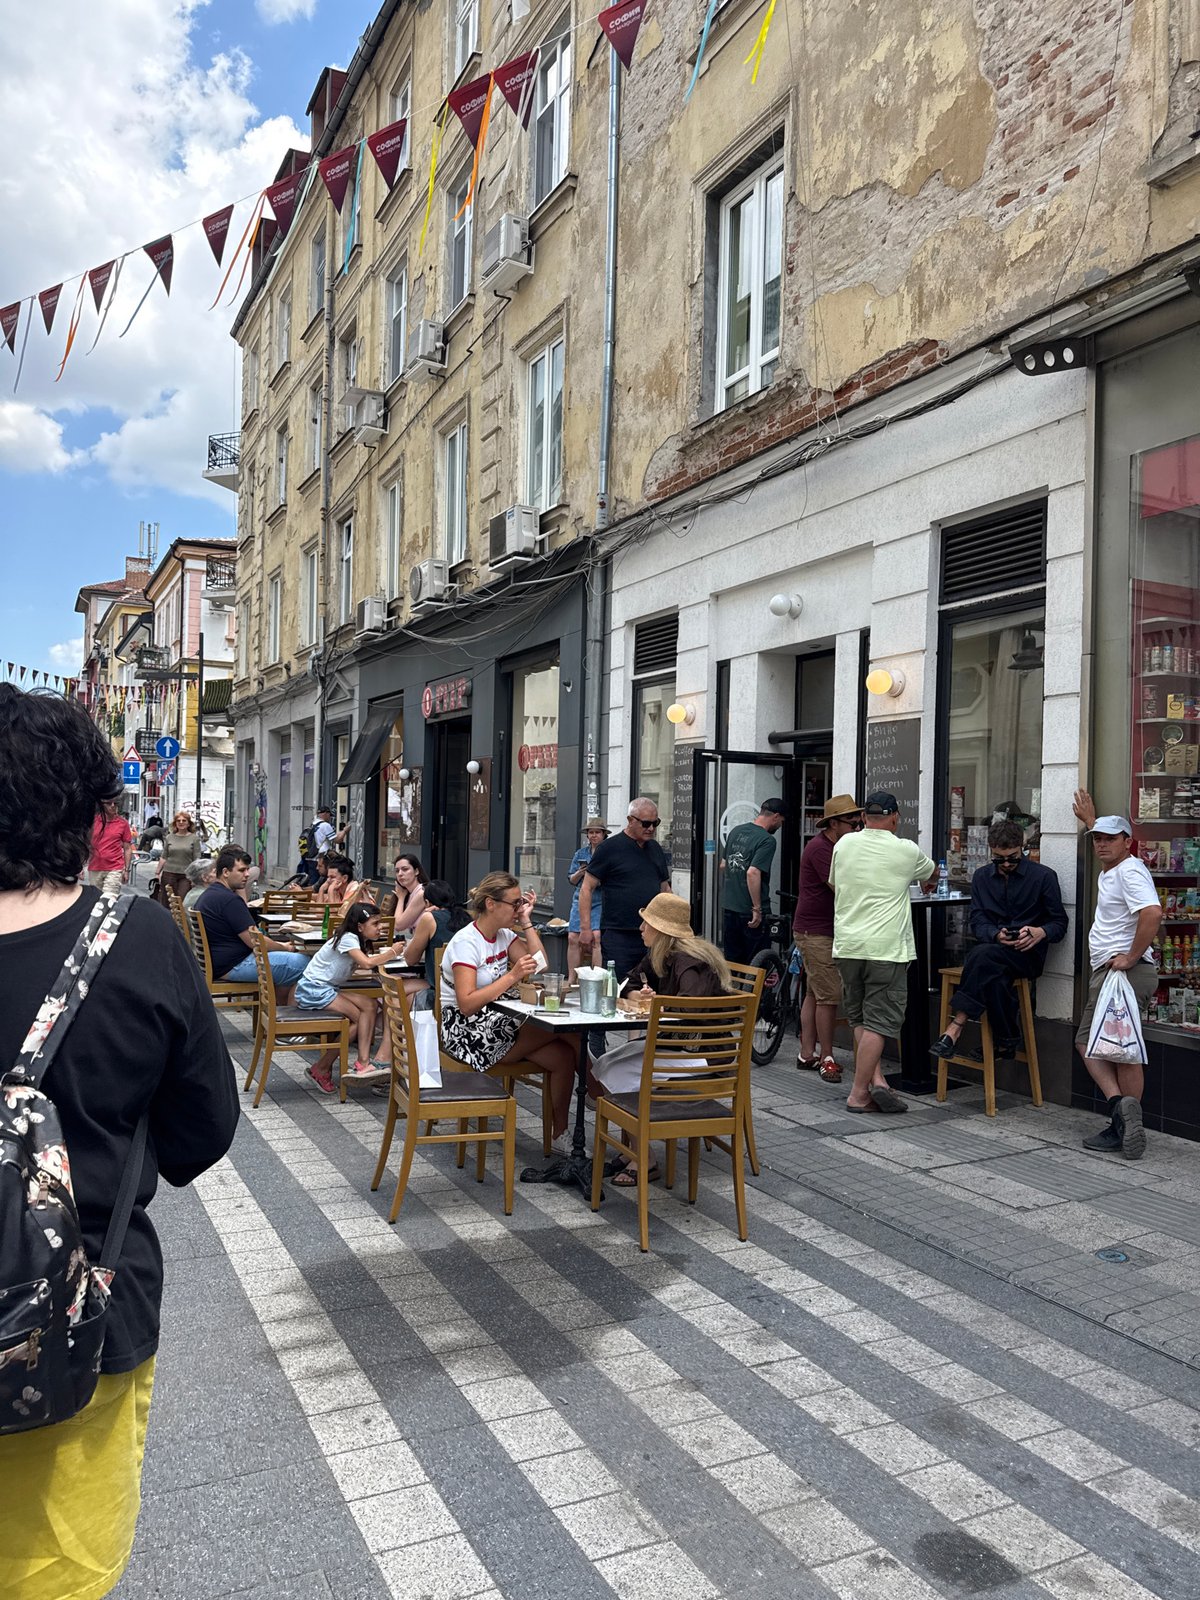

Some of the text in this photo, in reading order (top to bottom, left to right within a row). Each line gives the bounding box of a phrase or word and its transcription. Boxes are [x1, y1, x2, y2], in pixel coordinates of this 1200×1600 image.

[609, 6, 641, 29] СОФИЯ
[504, 67, 533, 88] СОФИЯ
[460, 93, 487, 113] СОФИЯ
[376, 135, 401, 152] СОФИЯ
[326, 160, 349, 177] СОФИЯ
[272, 187, 294, 203] СОФИЯ
